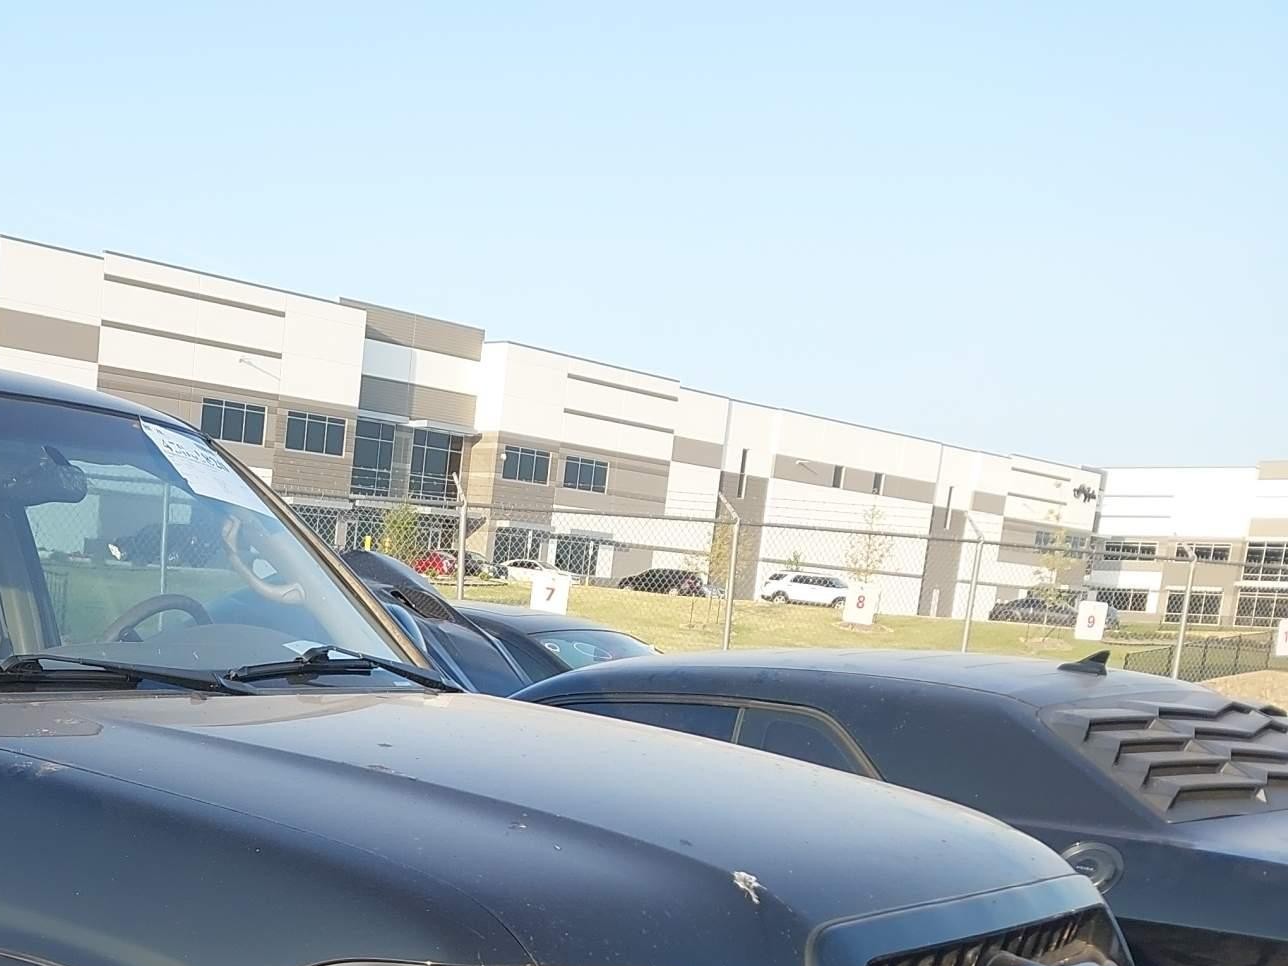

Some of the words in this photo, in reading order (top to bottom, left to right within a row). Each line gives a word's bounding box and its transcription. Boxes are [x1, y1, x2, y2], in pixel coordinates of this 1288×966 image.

[545, 586, 556, 602] 7
[856, 594, 866, 609] 8
[1087, 615, 1096, 629] 9
